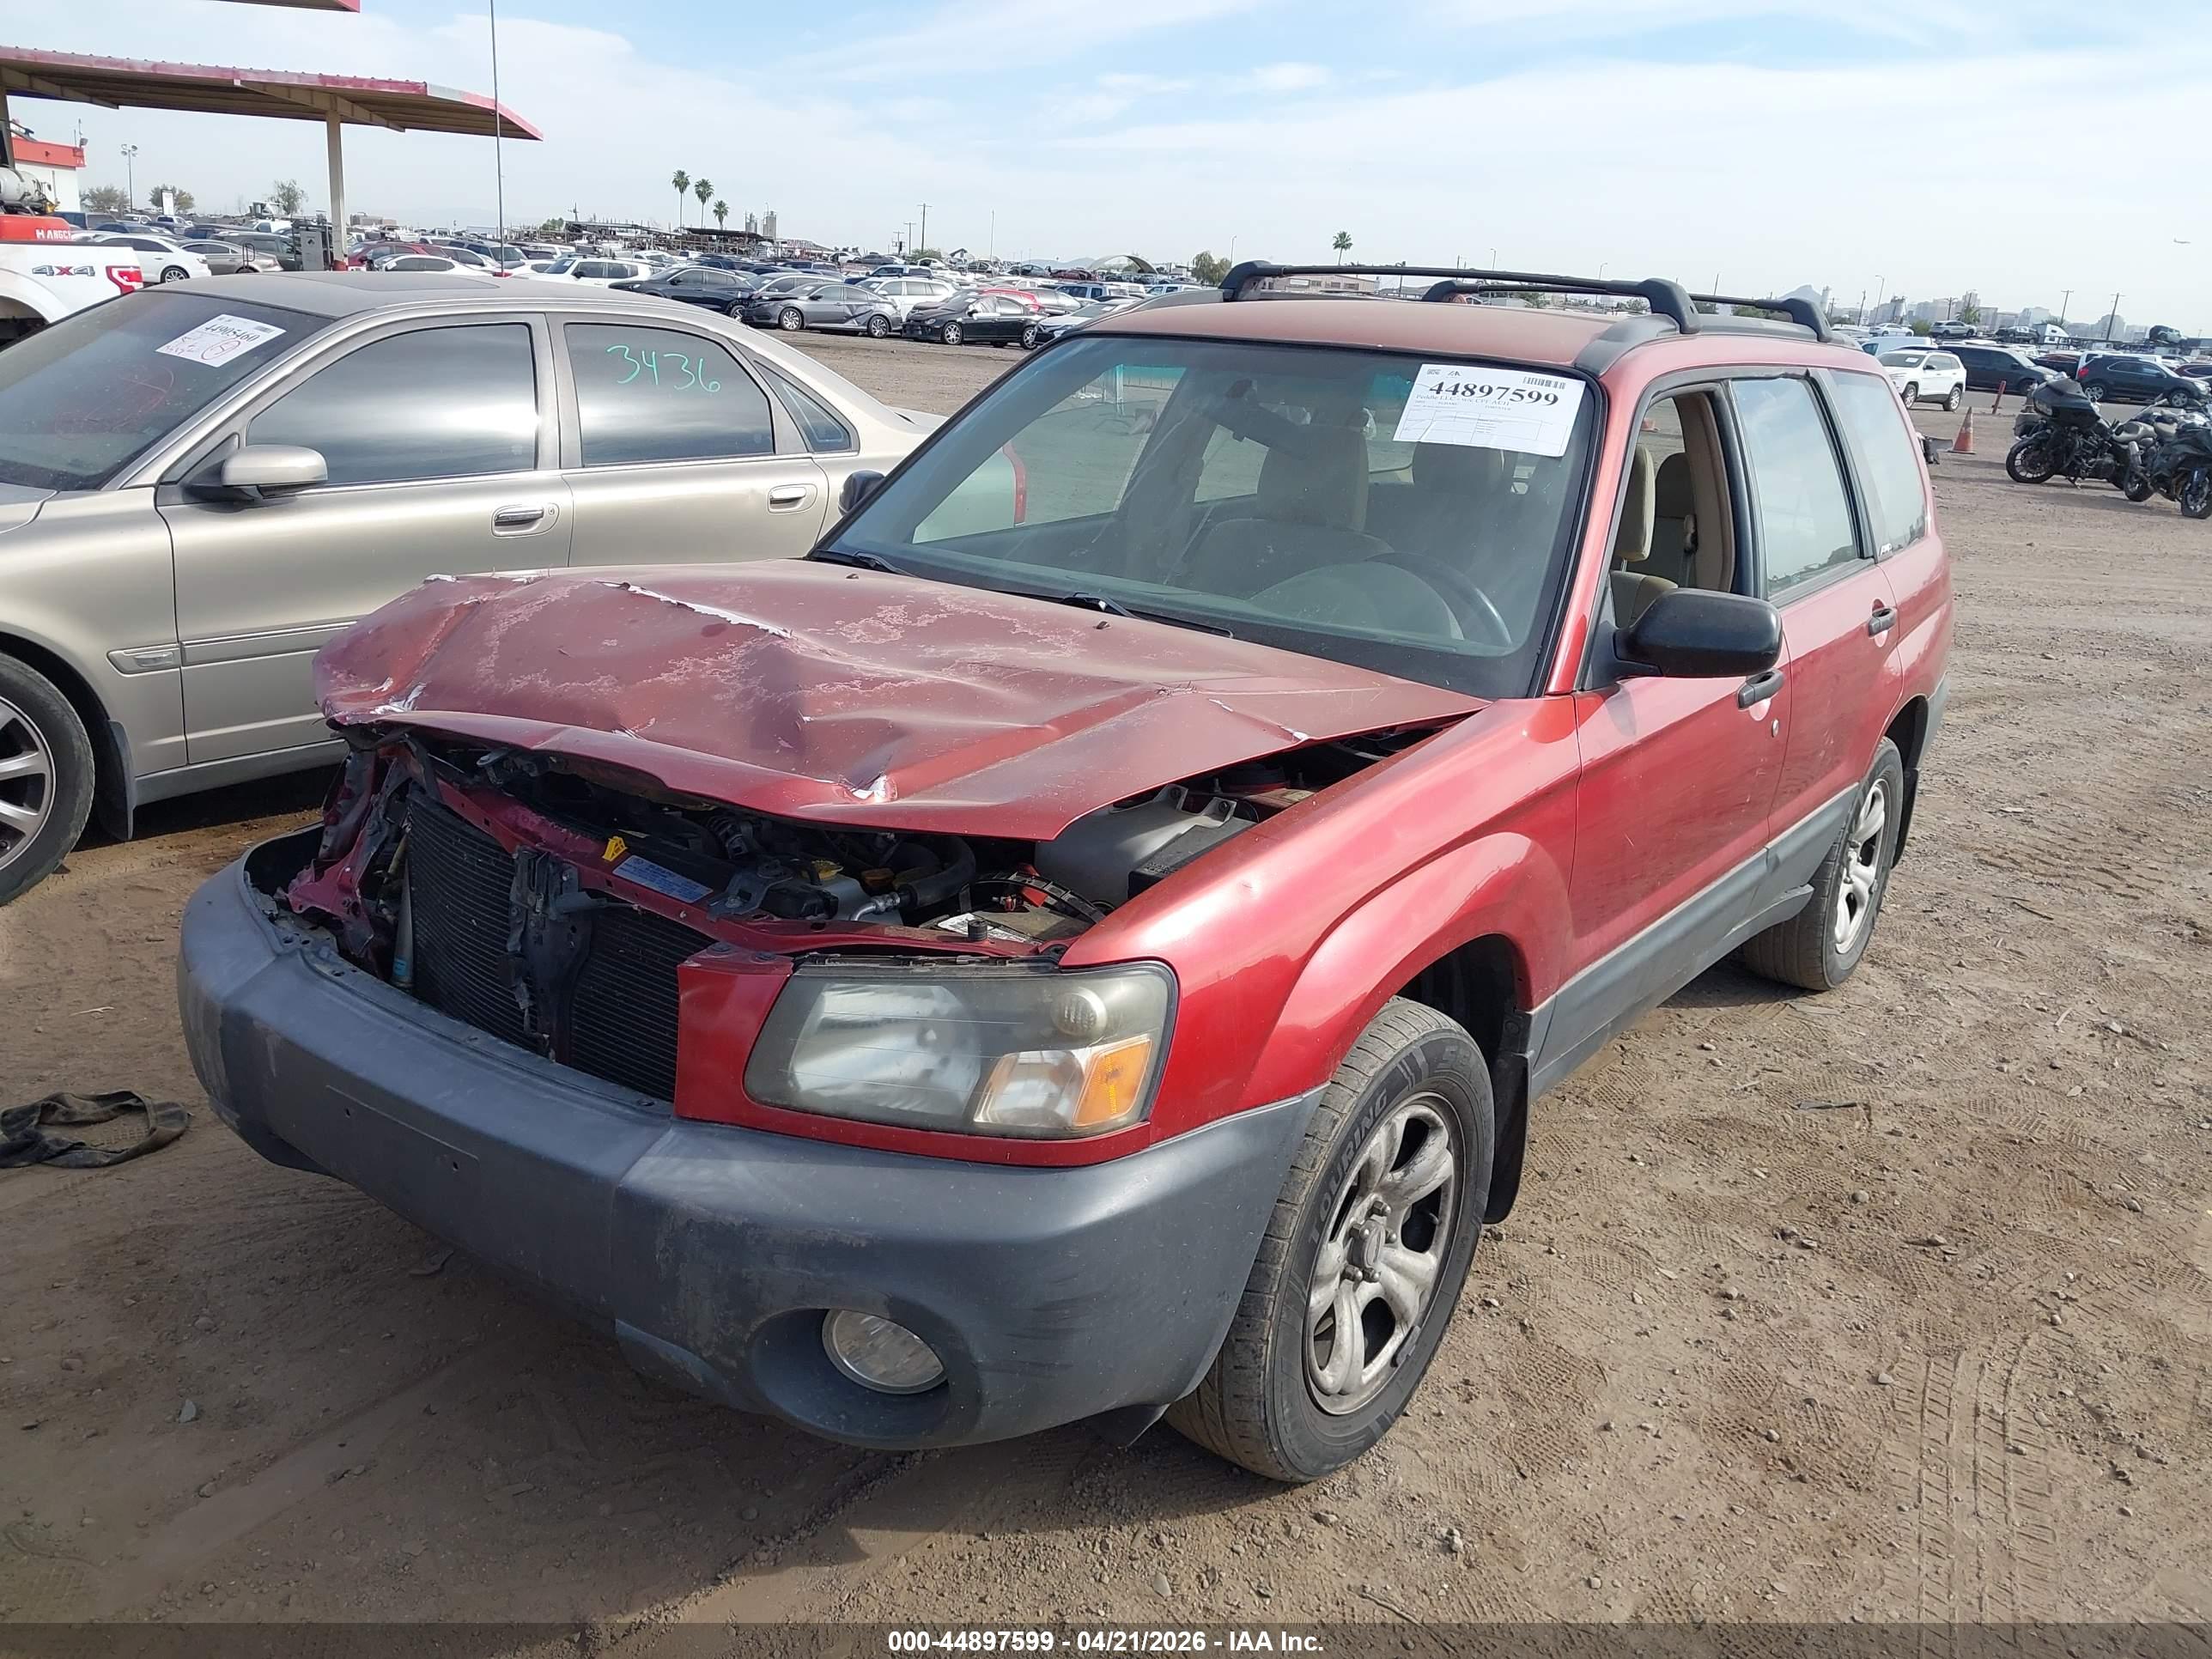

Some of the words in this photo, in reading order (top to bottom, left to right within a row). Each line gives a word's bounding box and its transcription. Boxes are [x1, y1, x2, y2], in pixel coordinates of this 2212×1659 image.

[606, 343, 721, 392] 3436
[1429, 380, 1559, 406] 44897599
[1308, 1087, 1389, 1244] TOURING
